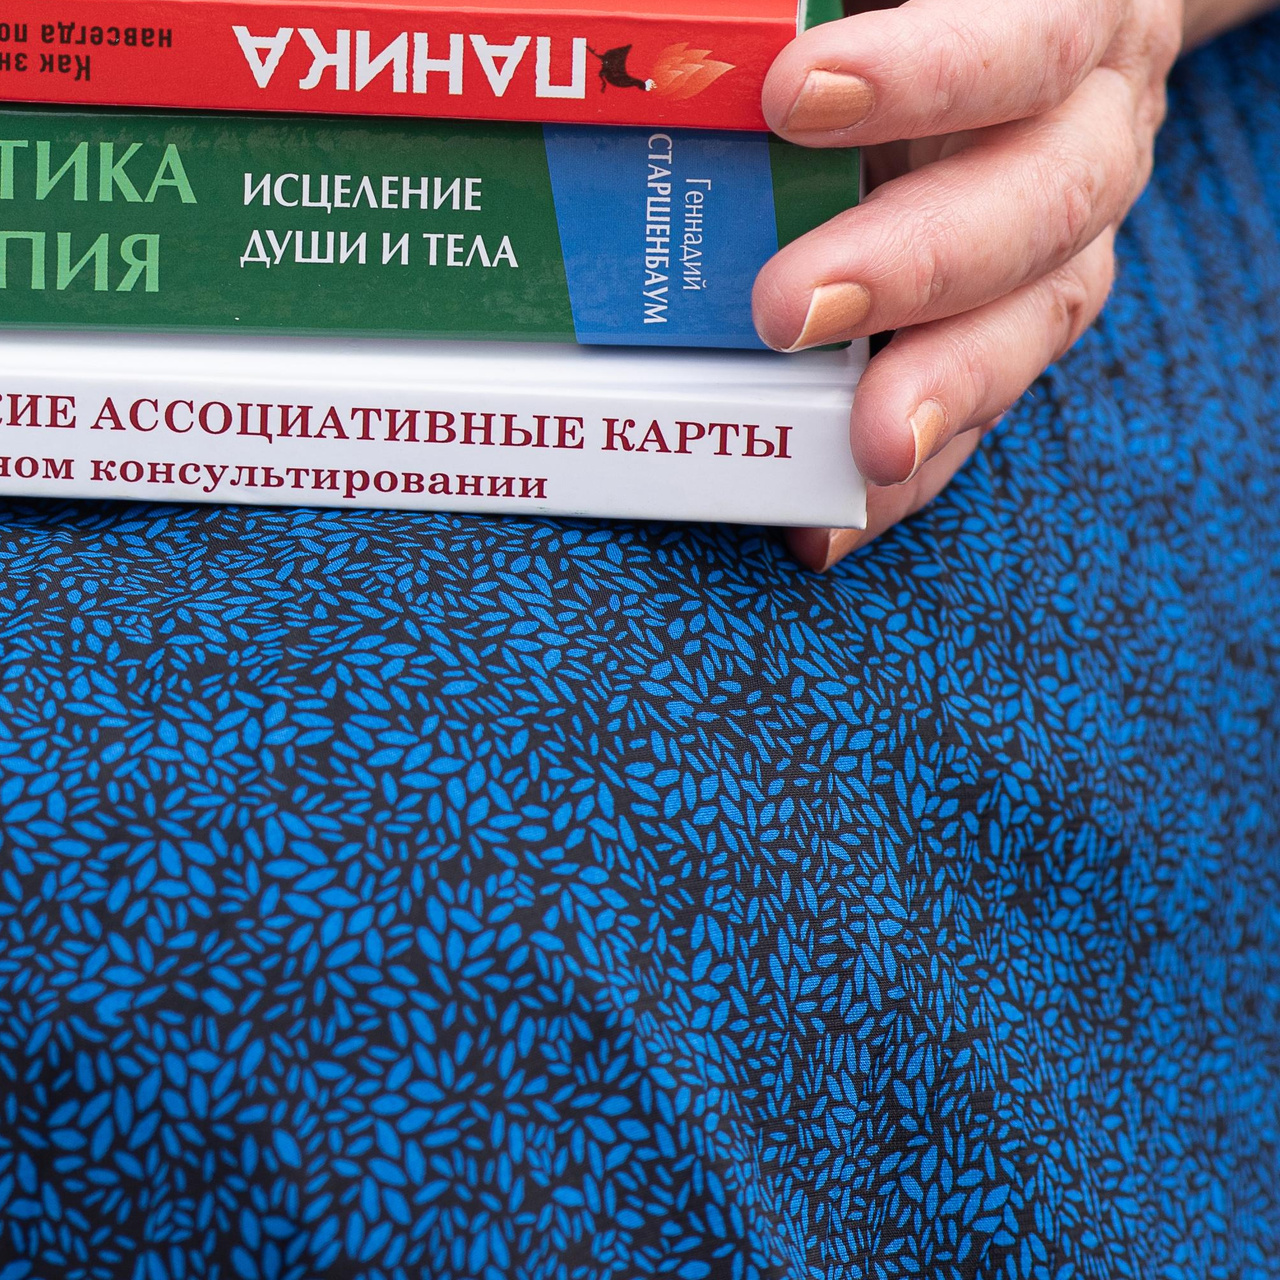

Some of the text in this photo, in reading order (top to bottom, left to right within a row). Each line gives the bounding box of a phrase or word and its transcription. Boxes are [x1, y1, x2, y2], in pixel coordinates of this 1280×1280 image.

[41, 21, 172, 48] навсегда
[39, 53, 91, 81] Как
[231, 25, 587, 99] ПАНИКА
[243, 172, 482, 214] ИСЦЕЛЕНИЕ
[239, 229, 519, 269] ДУШИ И ТЕЛА
[643, 133, 673, 324] СТАРШЕНБАУМ
[679, 178, 712, 291] Геннадий
[90, 396, 585, 450] АССОЦИАТИВНЫЕ
[601, 417, 793, 459] КАРТЫ
[89, 459, 549, 503] консультировании
